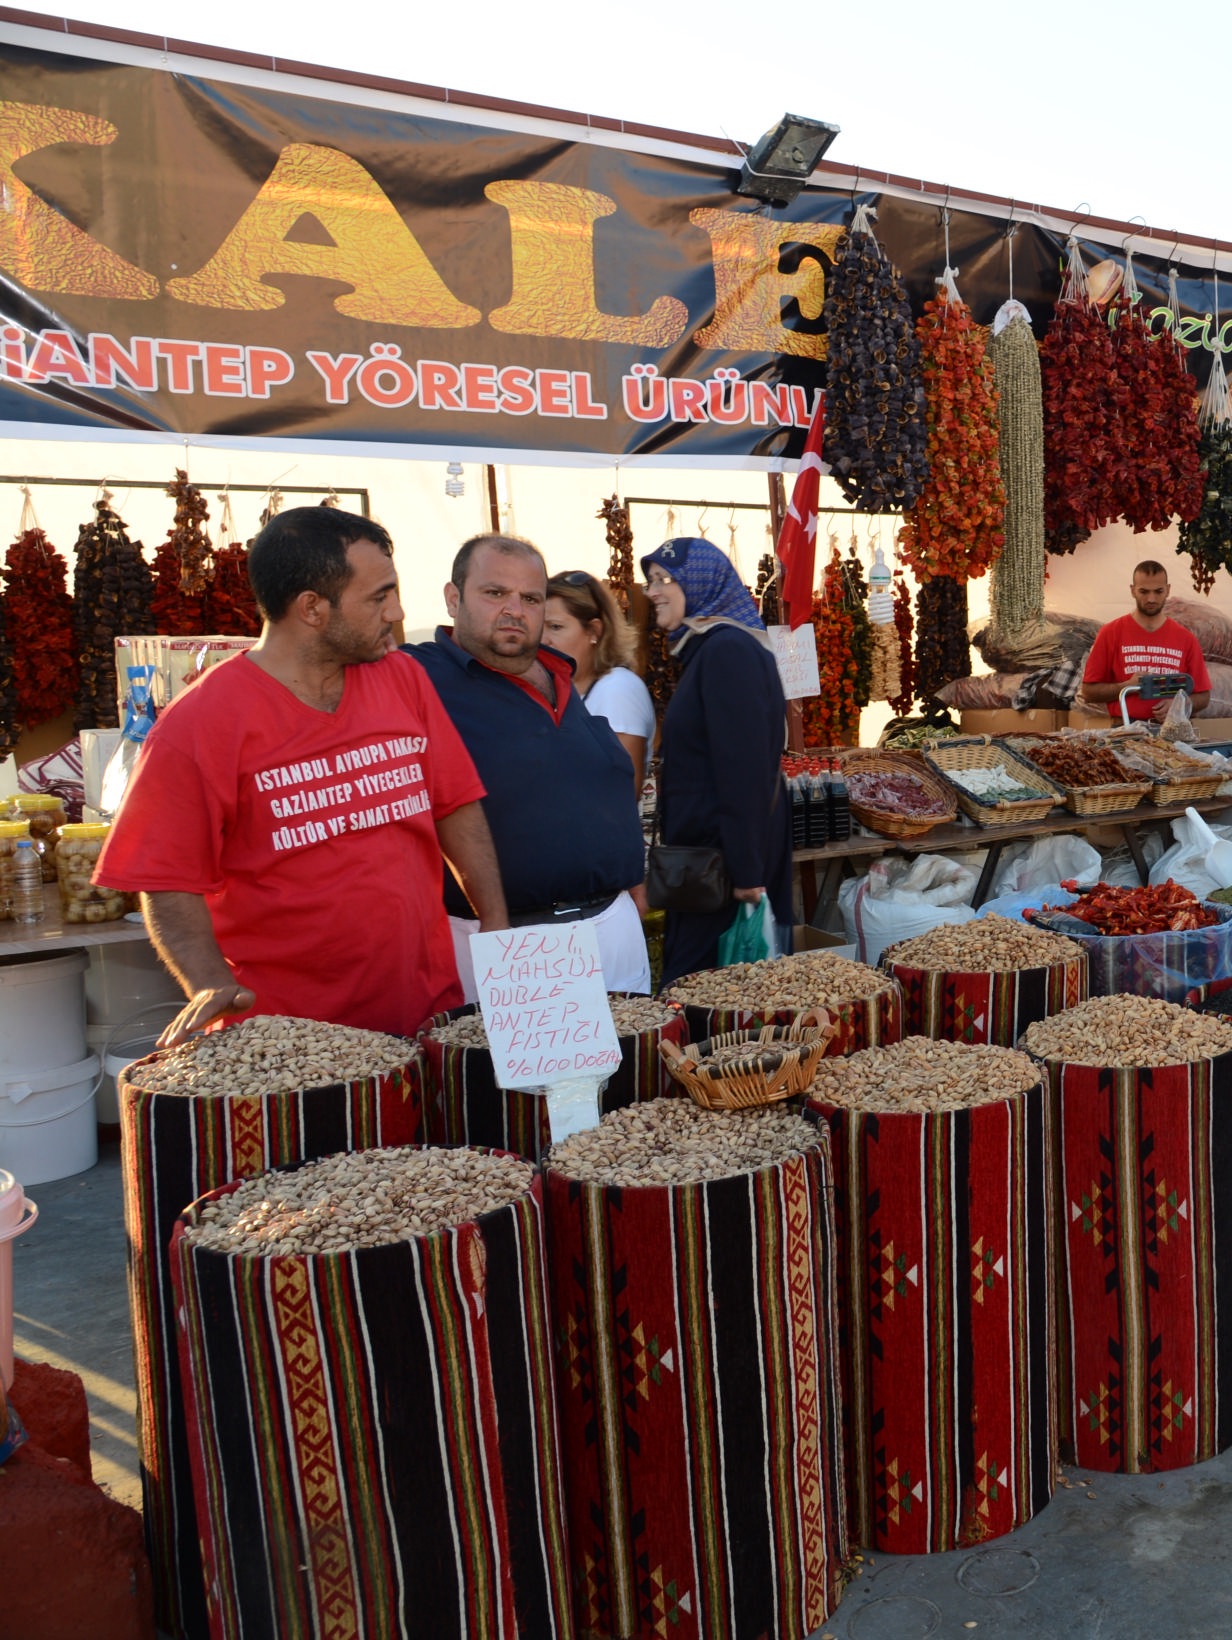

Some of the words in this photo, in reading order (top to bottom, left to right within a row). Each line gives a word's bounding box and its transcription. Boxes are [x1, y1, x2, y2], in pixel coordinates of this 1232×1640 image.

[308, 344, 608, 419] YÖRESEL
[622, 363, 826, 429] ÜRÜNL
[335, 743, 387, 774] AVRUPA
[270, 782, 352, 818] GAZİANTEP
[272, 821, 328, 850] KÜLTÜR
[328, 816, 346, 836] VE
[350, 805, 390, 830] SANAT
[496, 925, 578, 961] YENİ
[481, 948, 604, 986] MAHSÜL
[489, 981, 574, 1007] DUBLE
[489, 1002, 579, 1032] ANTEP
